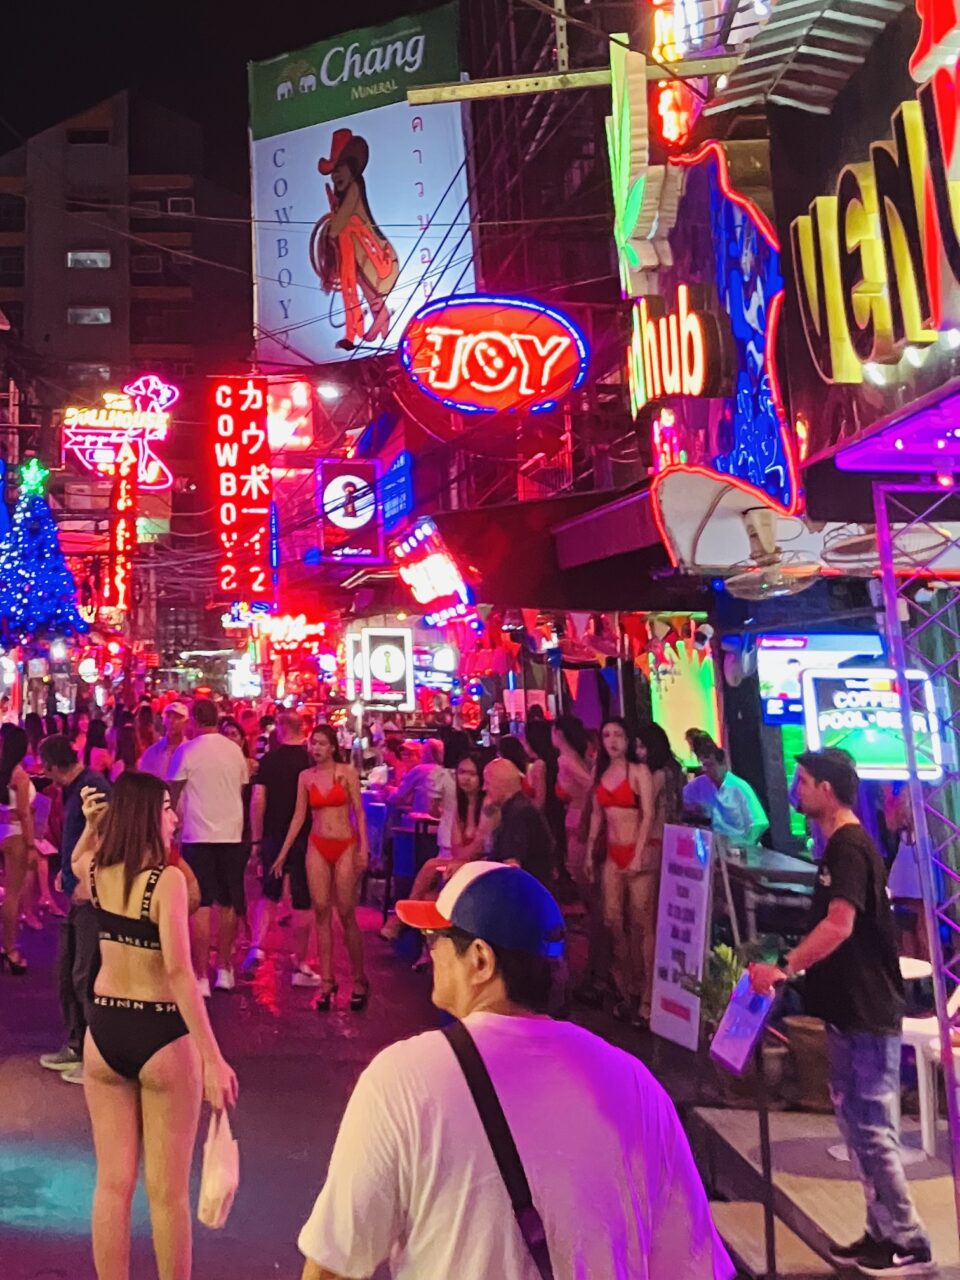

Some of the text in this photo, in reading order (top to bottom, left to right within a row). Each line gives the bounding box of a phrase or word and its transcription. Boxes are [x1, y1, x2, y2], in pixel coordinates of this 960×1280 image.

[320, 34, 426, 88] Chang
[272, 147, 294, 320] COWBOY
[425, 326, 571, 395] JOY
[215, 384, 238, 558] COWBOY
